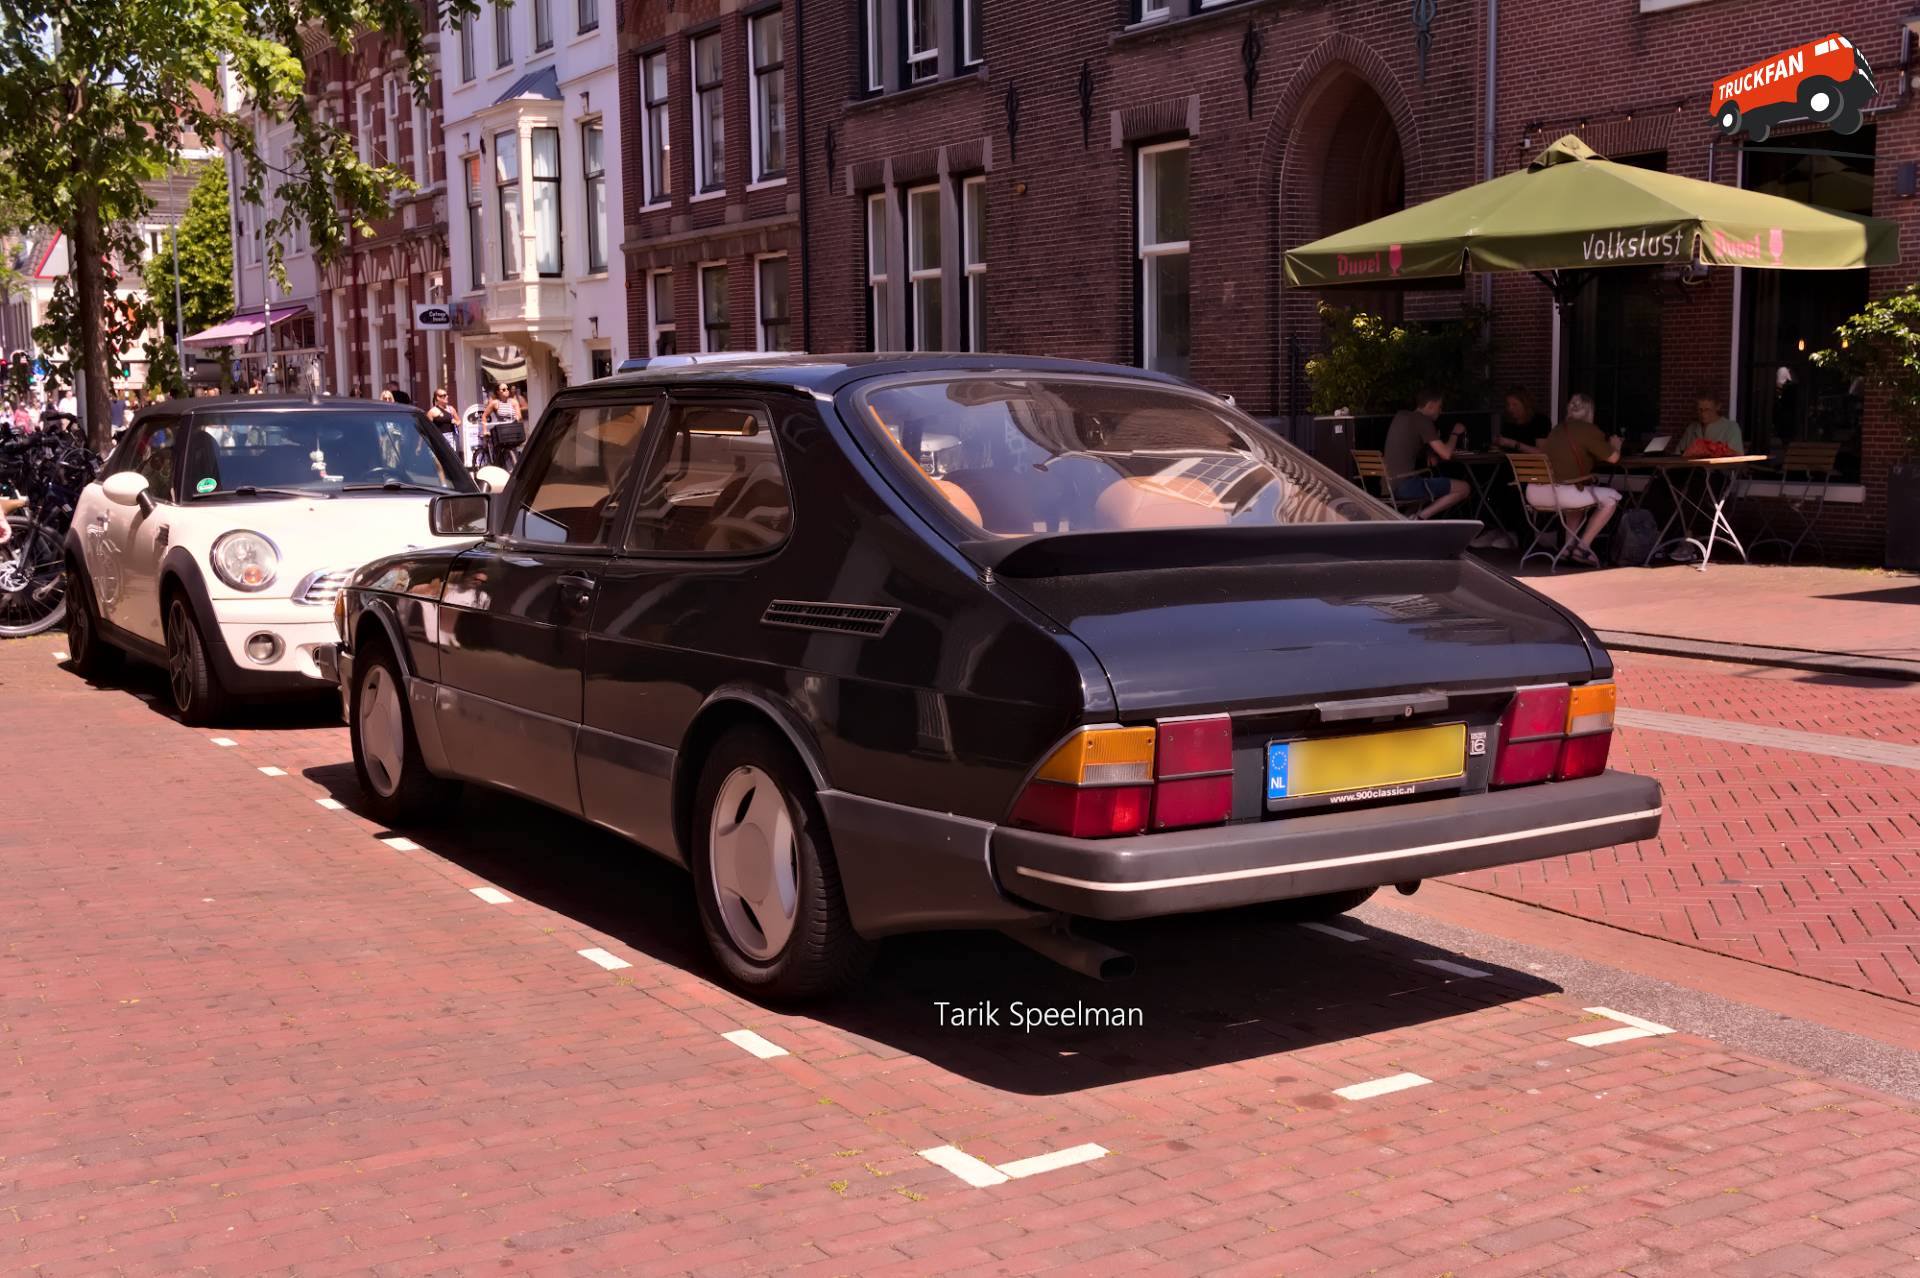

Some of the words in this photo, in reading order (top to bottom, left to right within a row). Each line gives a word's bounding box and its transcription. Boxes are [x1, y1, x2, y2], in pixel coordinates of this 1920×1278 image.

[1583, 229, 1683, 260] Volkslust
[1337, 251, 1380, 276] Duvel
[1270, 777, 1286, 789] NL
[1329, 785, 1416, 804] www.900classic.nl
